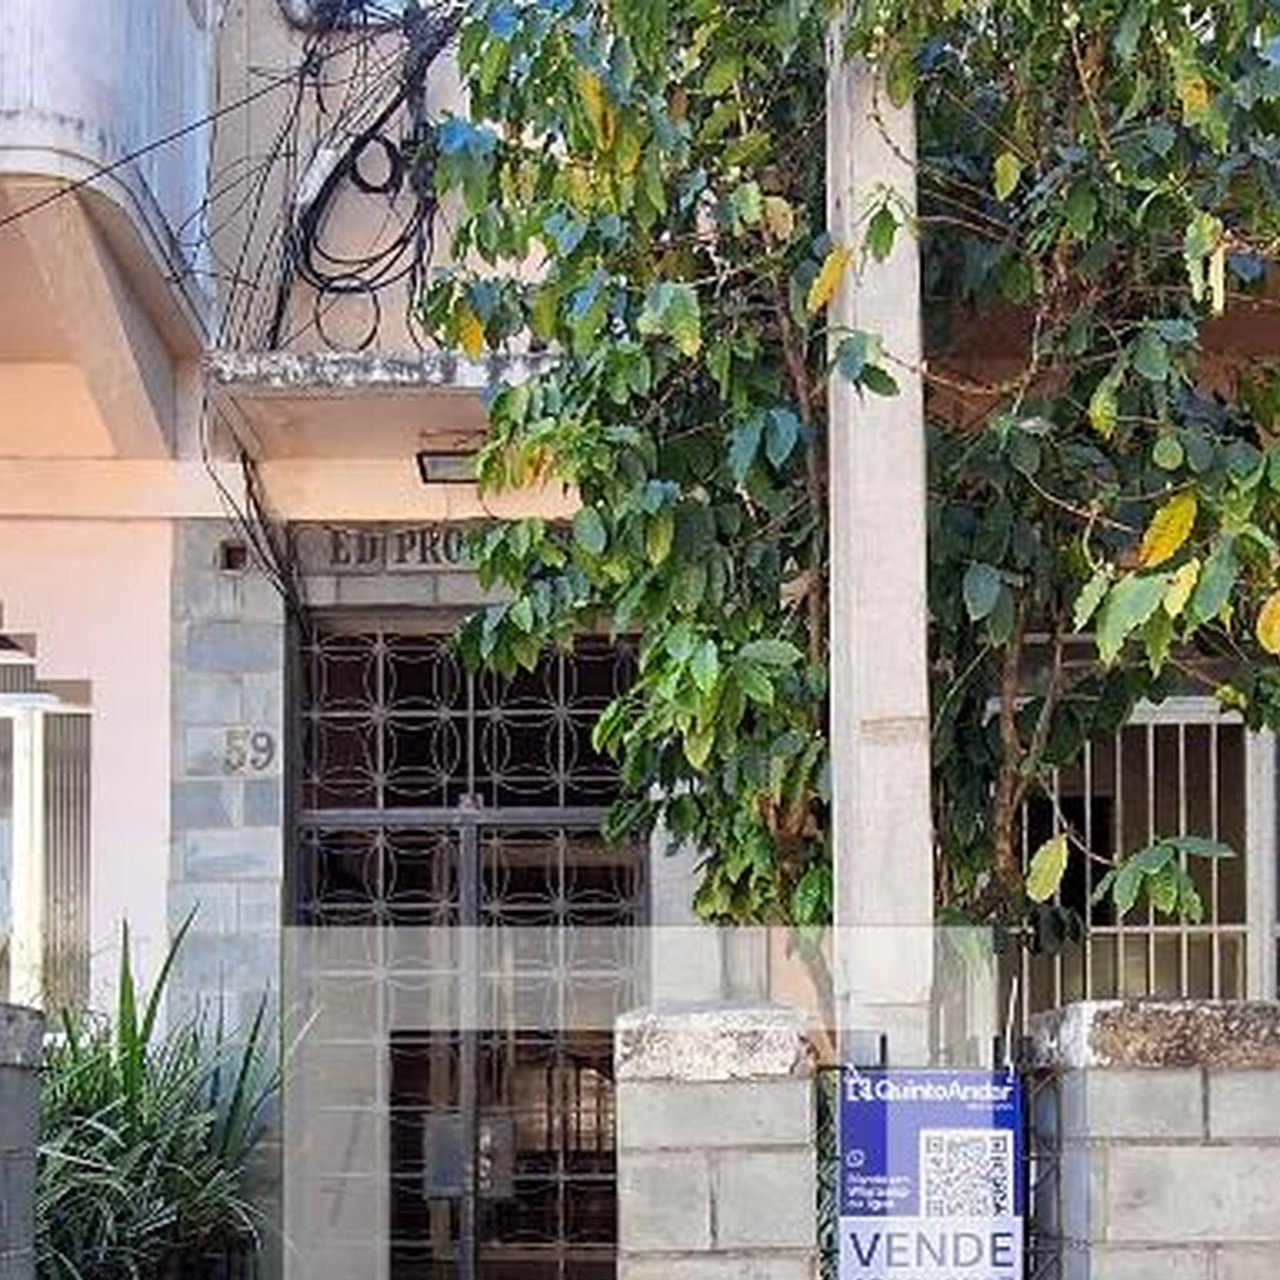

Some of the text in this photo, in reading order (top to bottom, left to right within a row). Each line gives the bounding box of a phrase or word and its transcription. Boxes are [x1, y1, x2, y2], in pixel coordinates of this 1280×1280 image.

[223, 728, 275, 774] 59
[875, 1079, 1014, 1101] QuintoAndar
[849, 1232, 1014, 1268] VENDE
